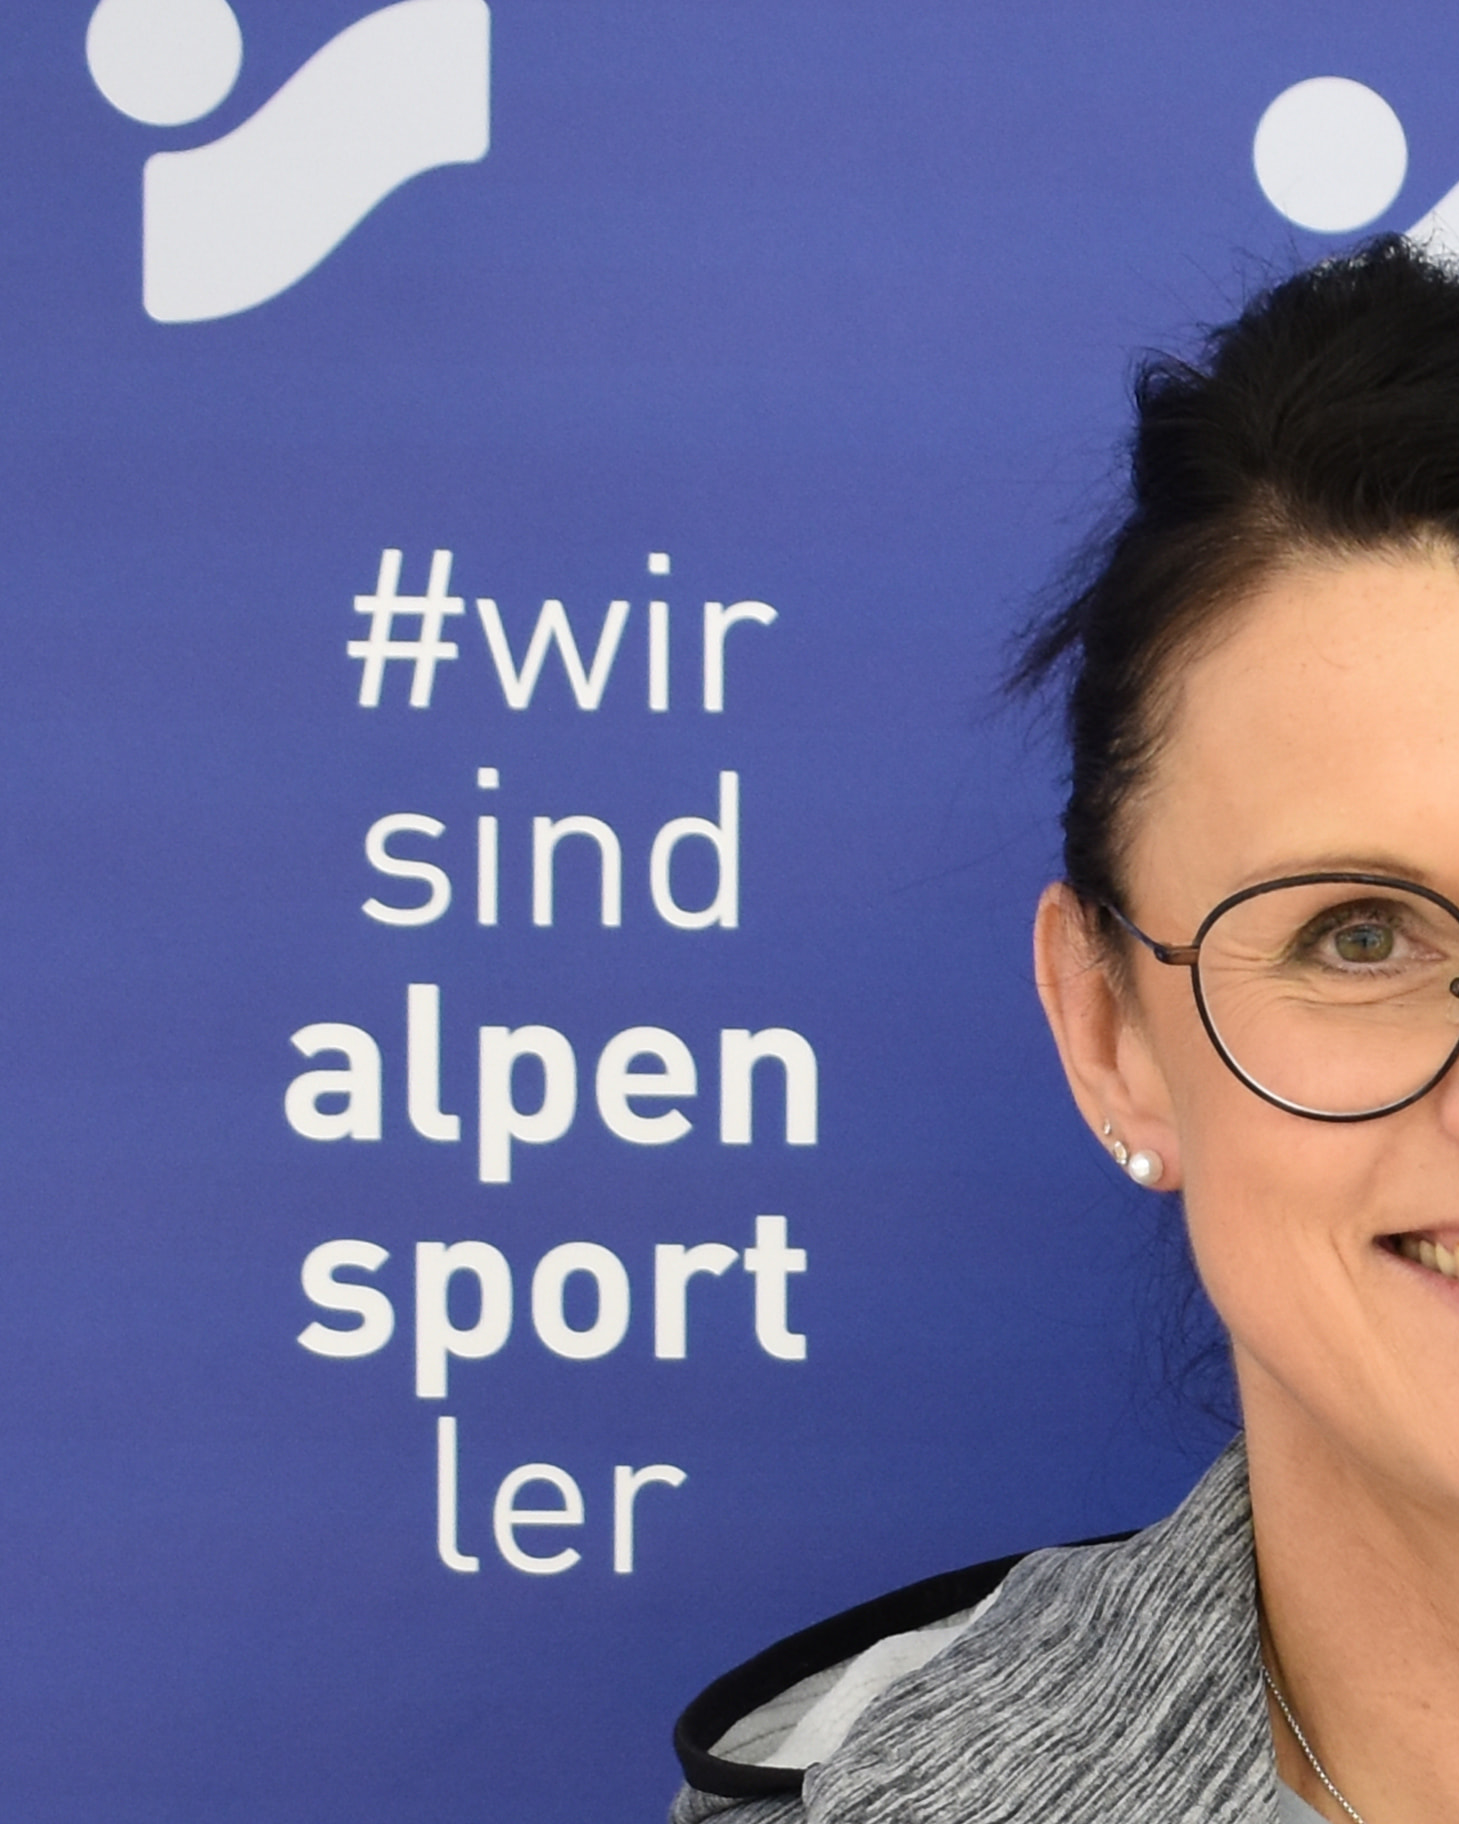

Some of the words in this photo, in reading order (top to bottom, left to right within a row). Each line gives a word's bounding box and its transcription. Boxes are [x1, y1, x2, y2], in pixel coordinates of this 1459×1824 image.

[346, 548, 778, 712] #wir
[361, 766, 739, 930] sind
[284, 982, 818, 1184] alpen
[296, 1214, 807, 1399] sport
[437, 1415, 687, 1575] ler
